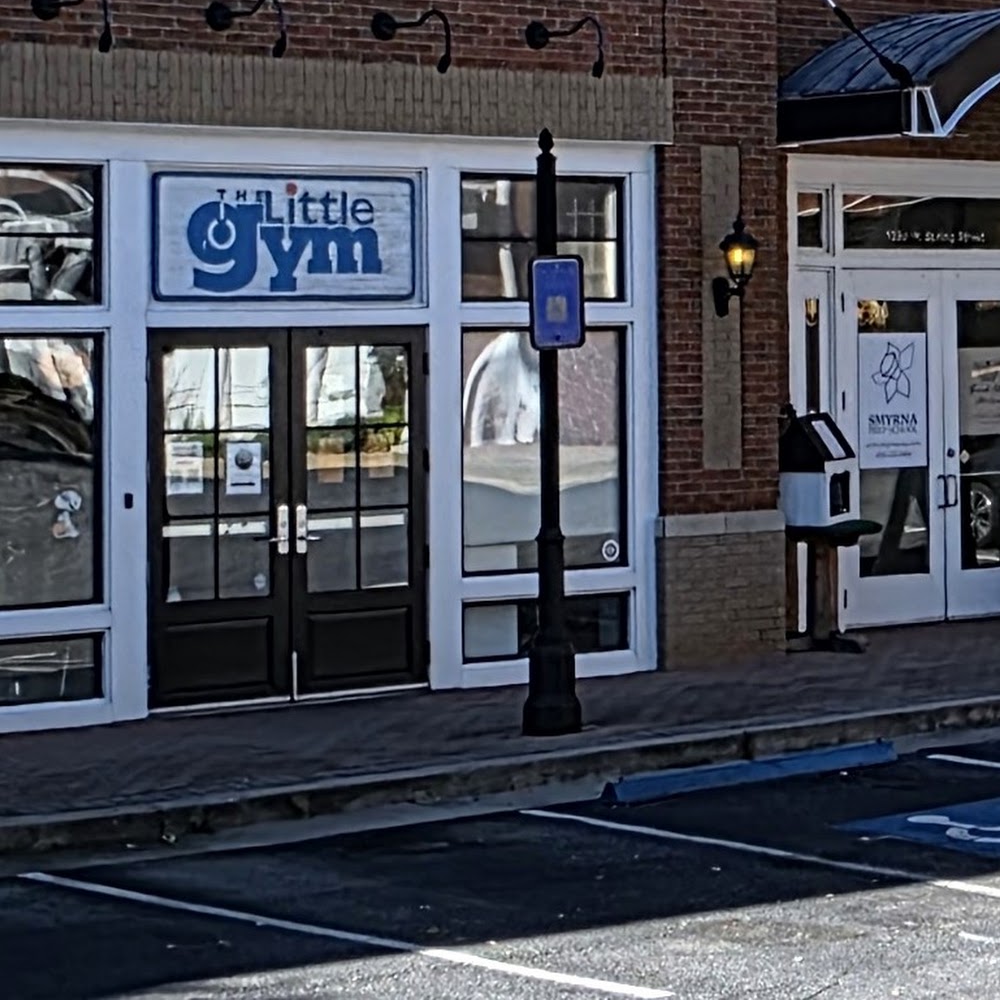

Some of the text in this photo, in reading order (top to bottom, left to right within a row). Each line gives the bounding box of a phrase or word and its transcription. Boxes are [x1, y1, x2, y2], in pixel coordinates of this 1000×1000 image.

[262, 182, 374, 225] Little
[187, 201, 382, 293] gym
[868, 413, 918, 426] SMYRNA
